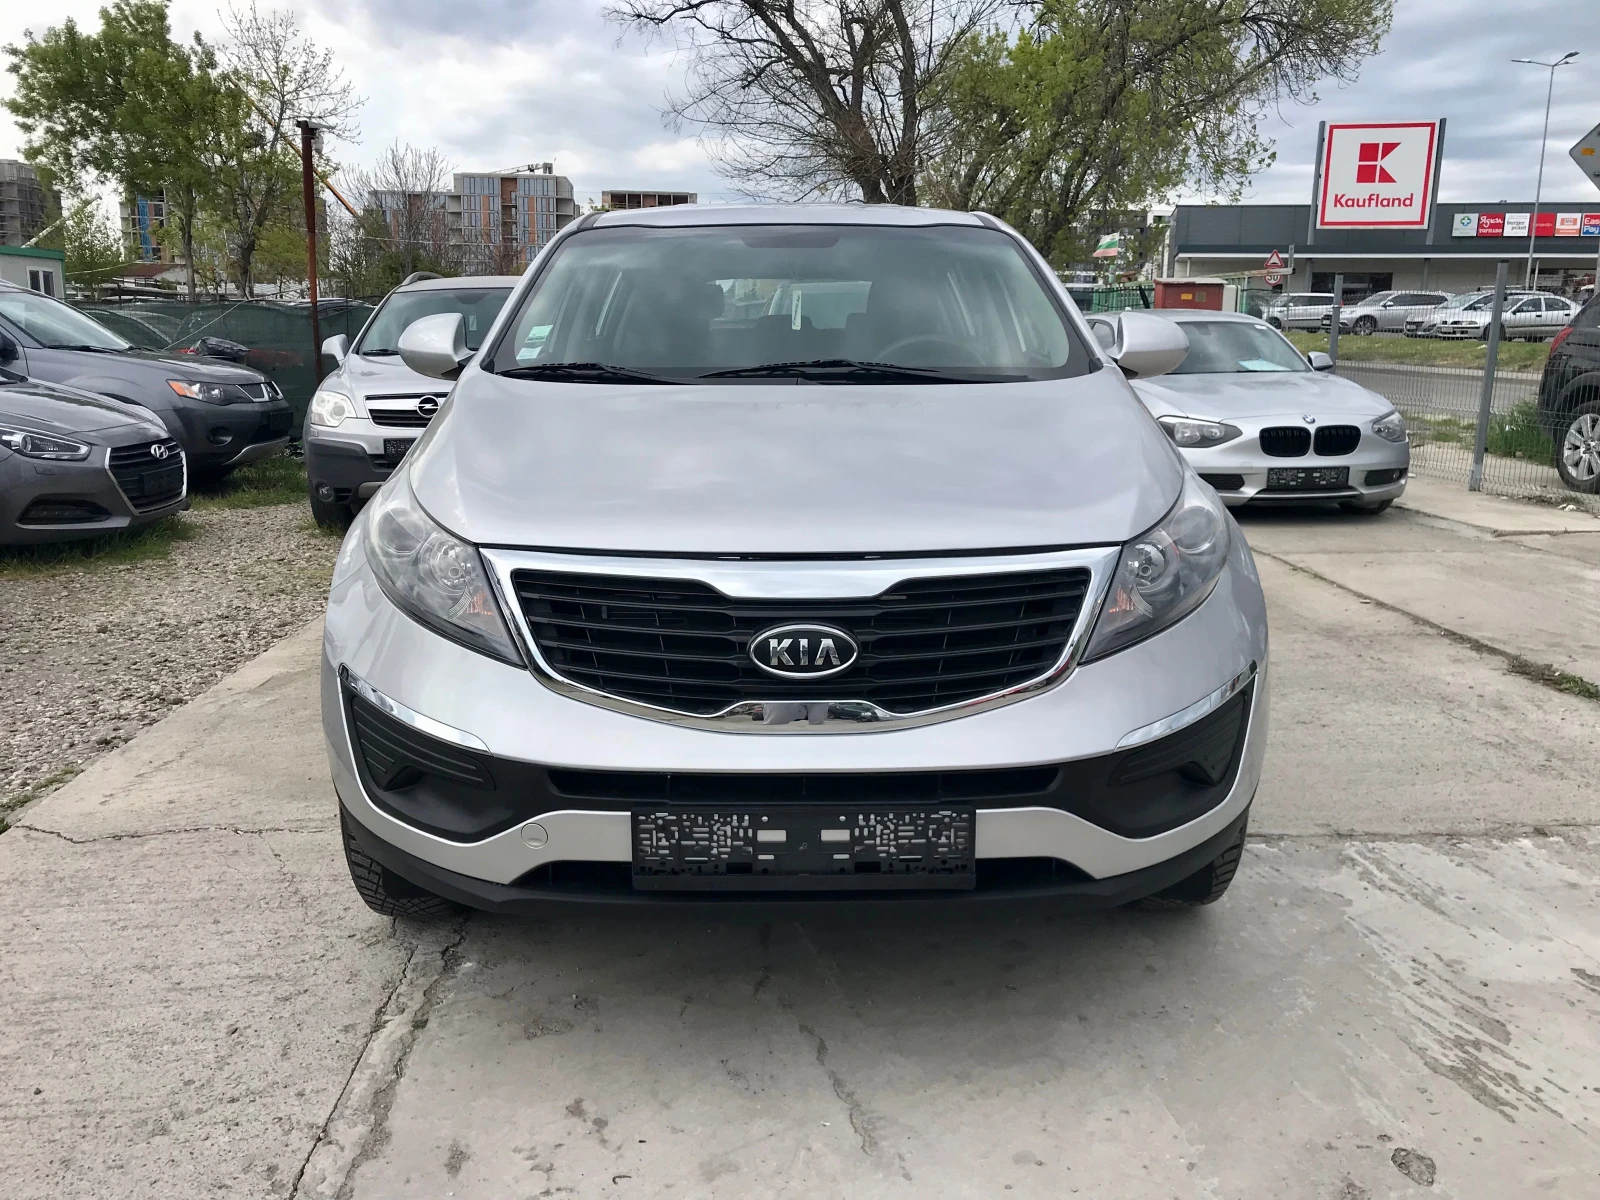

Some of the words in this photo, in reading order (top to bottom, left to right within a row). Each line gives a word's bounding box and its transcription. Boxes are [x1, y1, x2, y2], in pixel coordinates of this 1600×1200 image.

[1334, 193, 1414, 208] Kaufland
[1585, 217, 1600, 226] Eas
[1584, 226, 1600, 234] Pay
[768, 638, 841, 666] KIA
